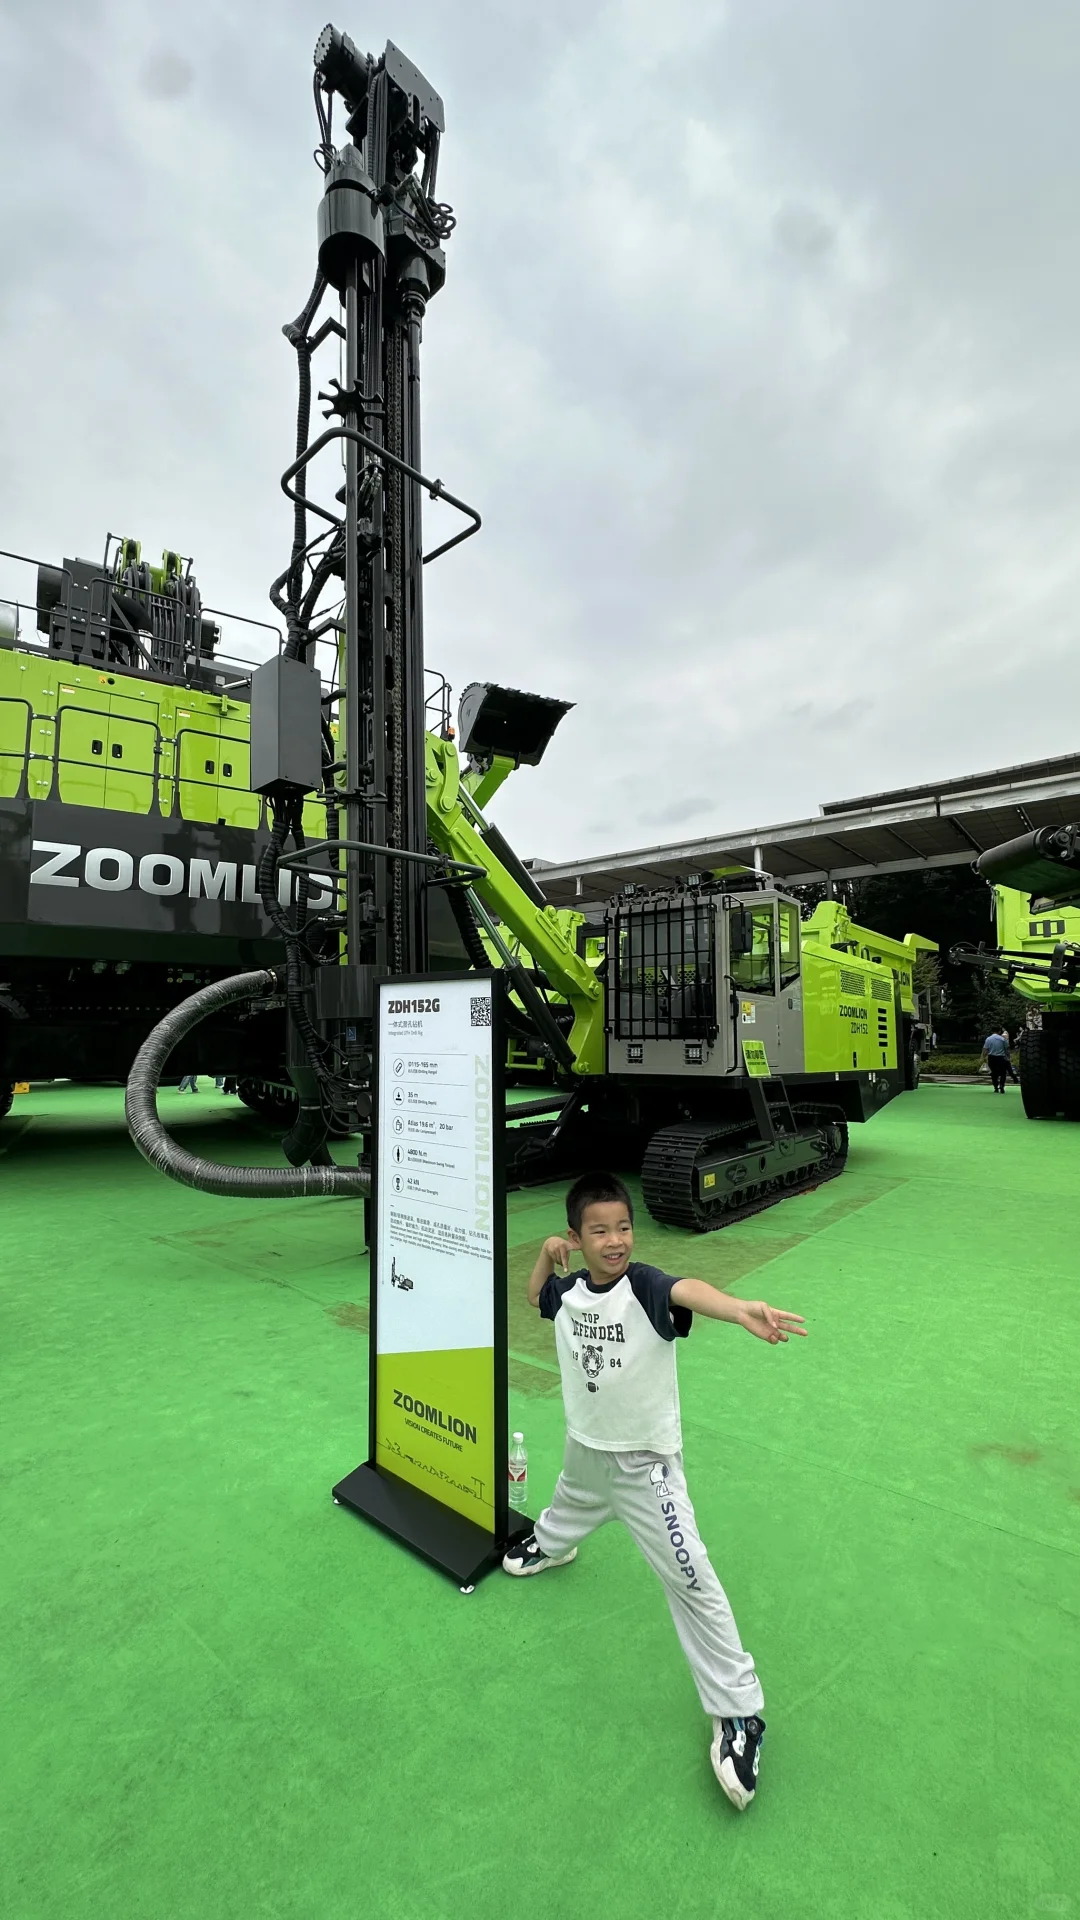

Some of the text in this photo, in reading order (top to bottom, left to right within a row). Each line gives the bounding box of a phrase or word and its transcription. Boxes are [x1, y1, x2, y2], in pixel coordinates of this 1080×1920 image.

[30, 840, 340, 910] ZOOMLIO
[388, 998, 440, 1014] ZDH152G
[839, 1005, 868, 1019] ZOOMLION
[851, 1022, 868, 1034] ZDH152
[474, 1055, 490, 1232] ZOOMLION
[582, 1312, 600, 1324] TOP
[610, 1358, 622, 1368] 84
[393, 1389, 477, 1444] ZOOMLION
[405, 1417, 463, 1452] VISION CREATES FUTURE
[661, 1501, 701, 1591] SNOOPY
